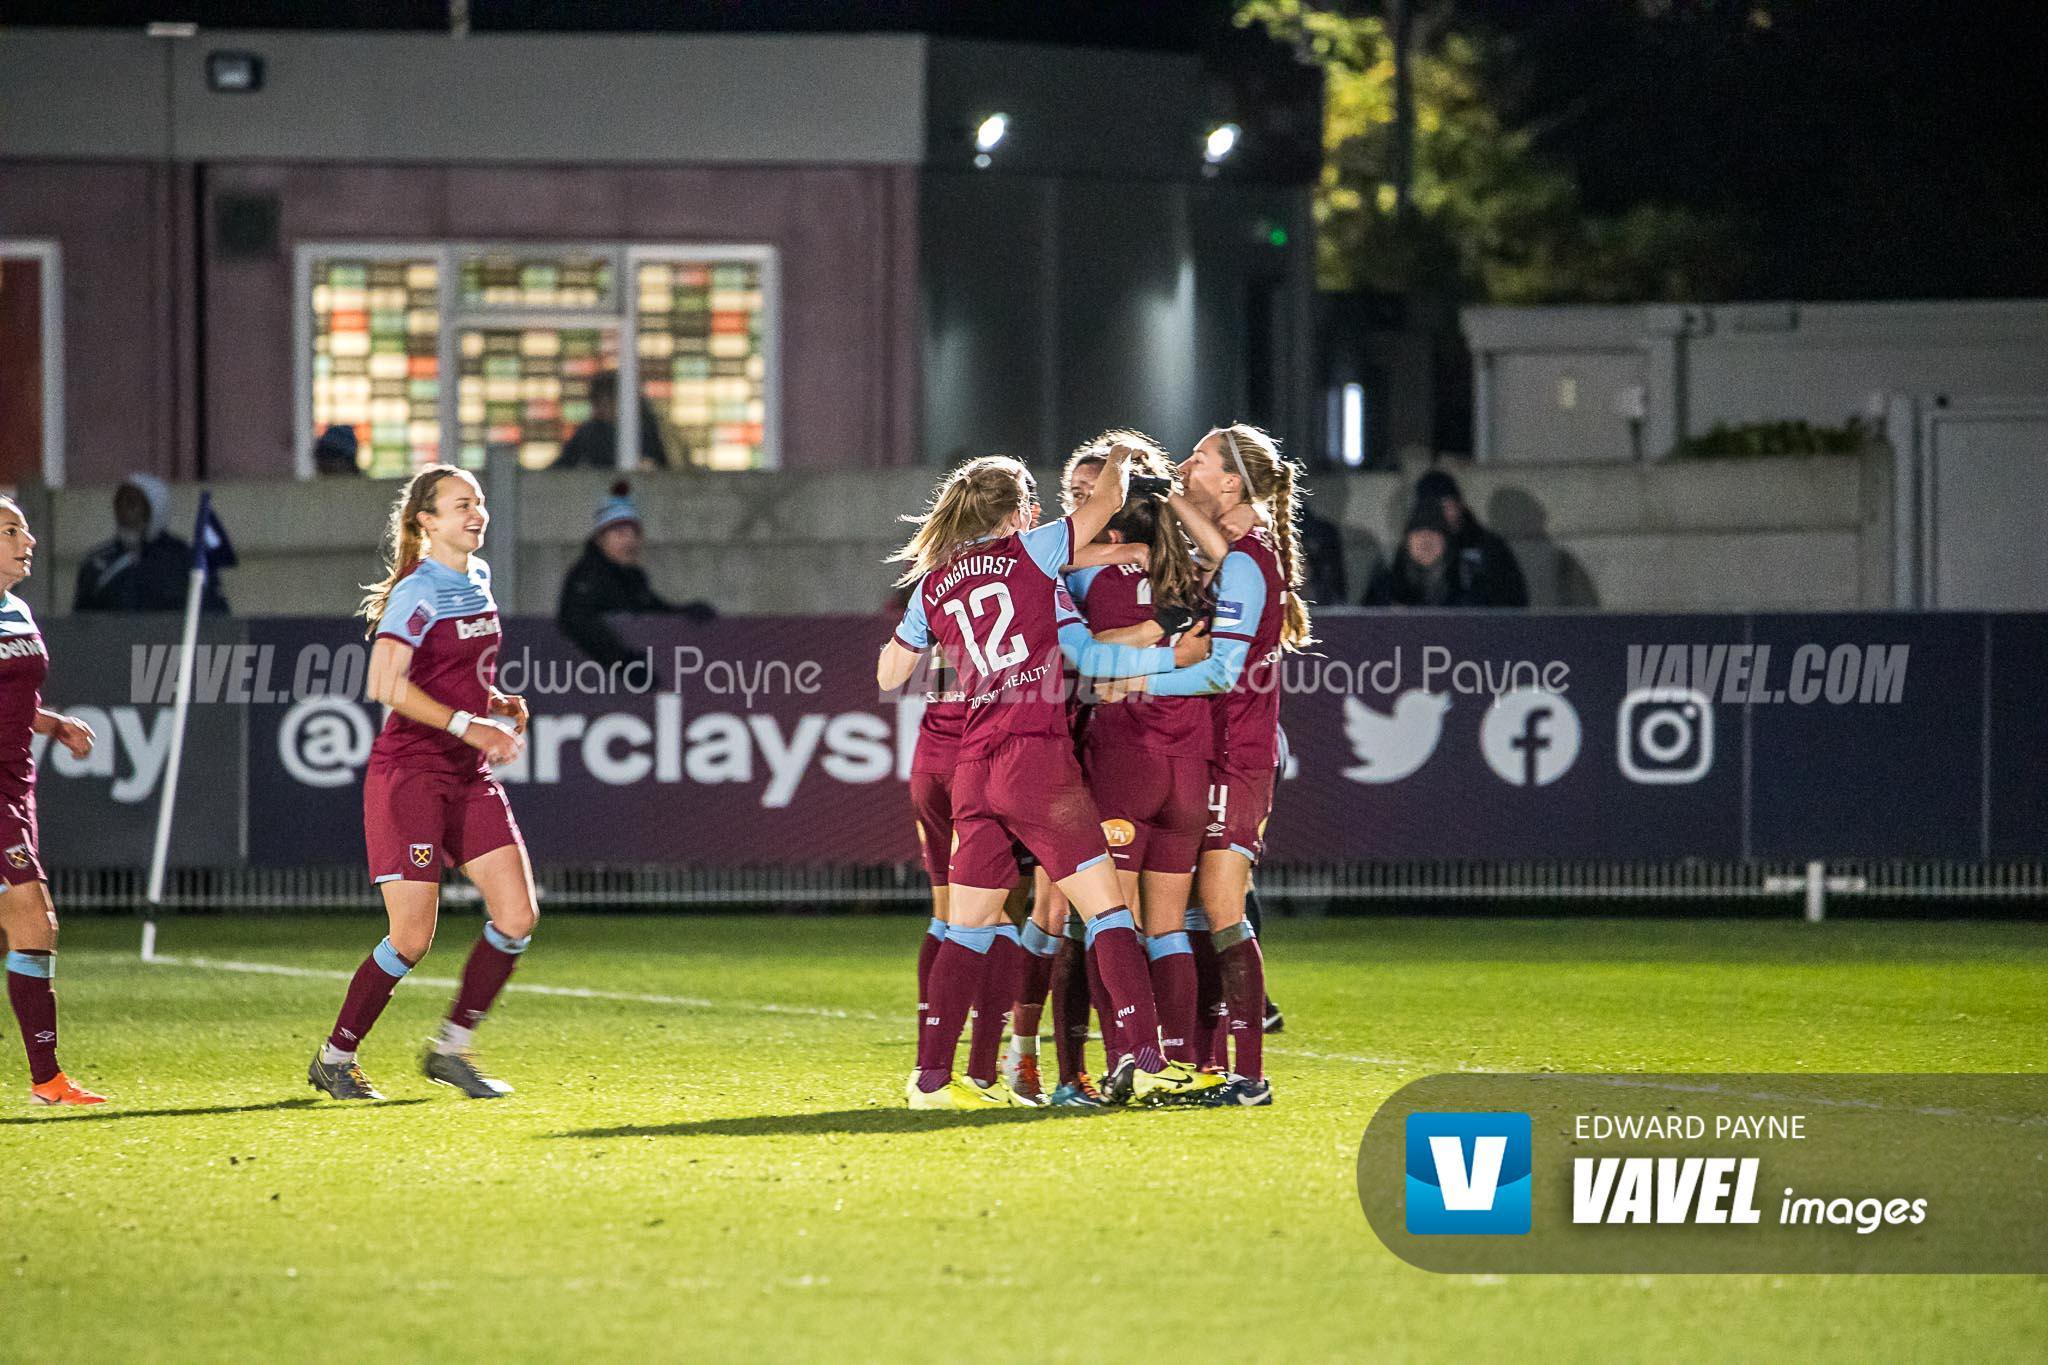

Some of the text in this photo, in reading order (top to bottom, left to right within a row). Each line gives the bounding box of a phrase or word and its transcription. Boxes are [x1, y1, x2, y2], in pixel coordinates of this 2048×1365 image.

[924, 555, 1018, 607] LONGHURST
[942, 581, 1030, 678] 12
[30, 705, 177, 803] ay
[1207, 784, 1228, 823] 4
